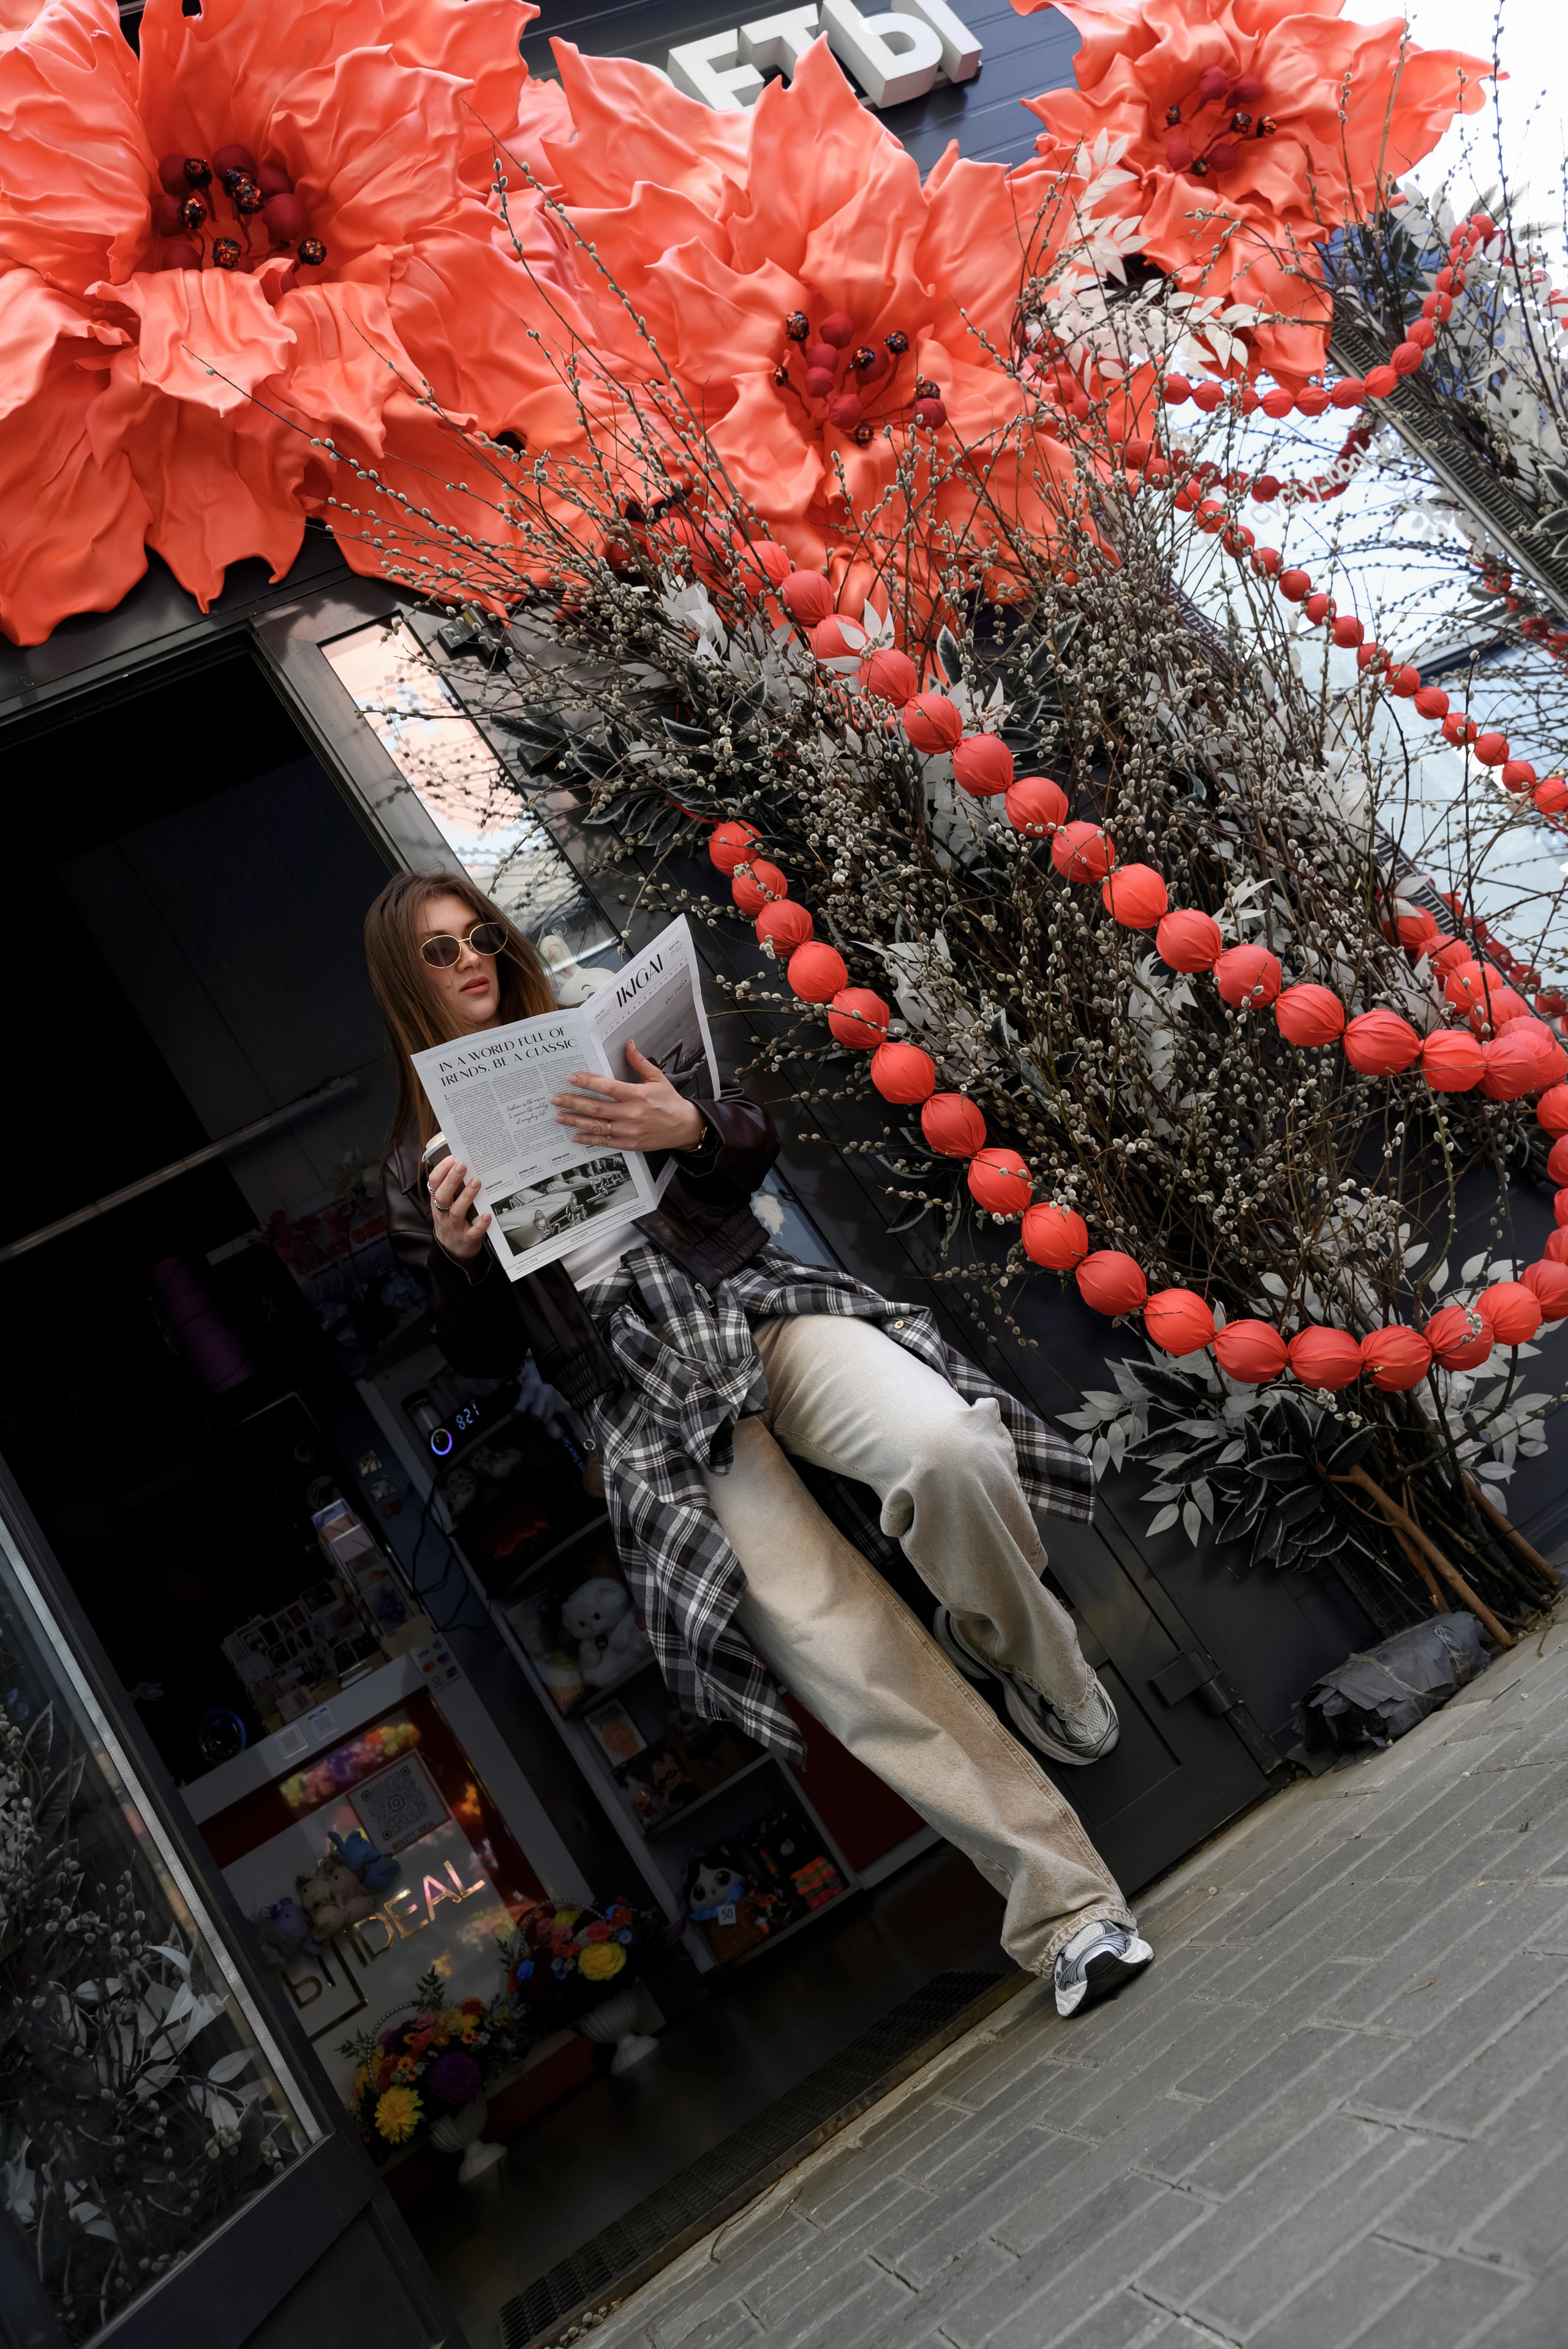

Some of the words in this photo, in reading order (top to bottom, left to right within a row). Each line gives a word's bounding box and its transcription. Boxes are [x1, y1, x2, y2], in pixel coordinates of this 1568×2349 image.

[643, 0, 983, 113] ЕТЫ
[616, 953, 663, 1008] IKIGAI
[439, 1061, 453, 1072] IN
[458, 1057, 466, 1066] A
[468, 1041, 514, 1061] WORLD
[518, 1032, 546, 1046] FULL
[549, 1027, 564, 1038] OF
[439, 1064, 490, 1086] TRENDS,
[492, 1057, 510, 1068] BE
[514, 1054, 522, 1062] A
[526, 1039, 578, 1058] CLASSIC
[621, 1205, 646, 1217] LUXURIOUS
[570, 1231, 588, 1242] ELEGANT
[515, 1257, 538, 1271] SEDUCTIVE
[342, 1861, 485, 1966] IDEAL
